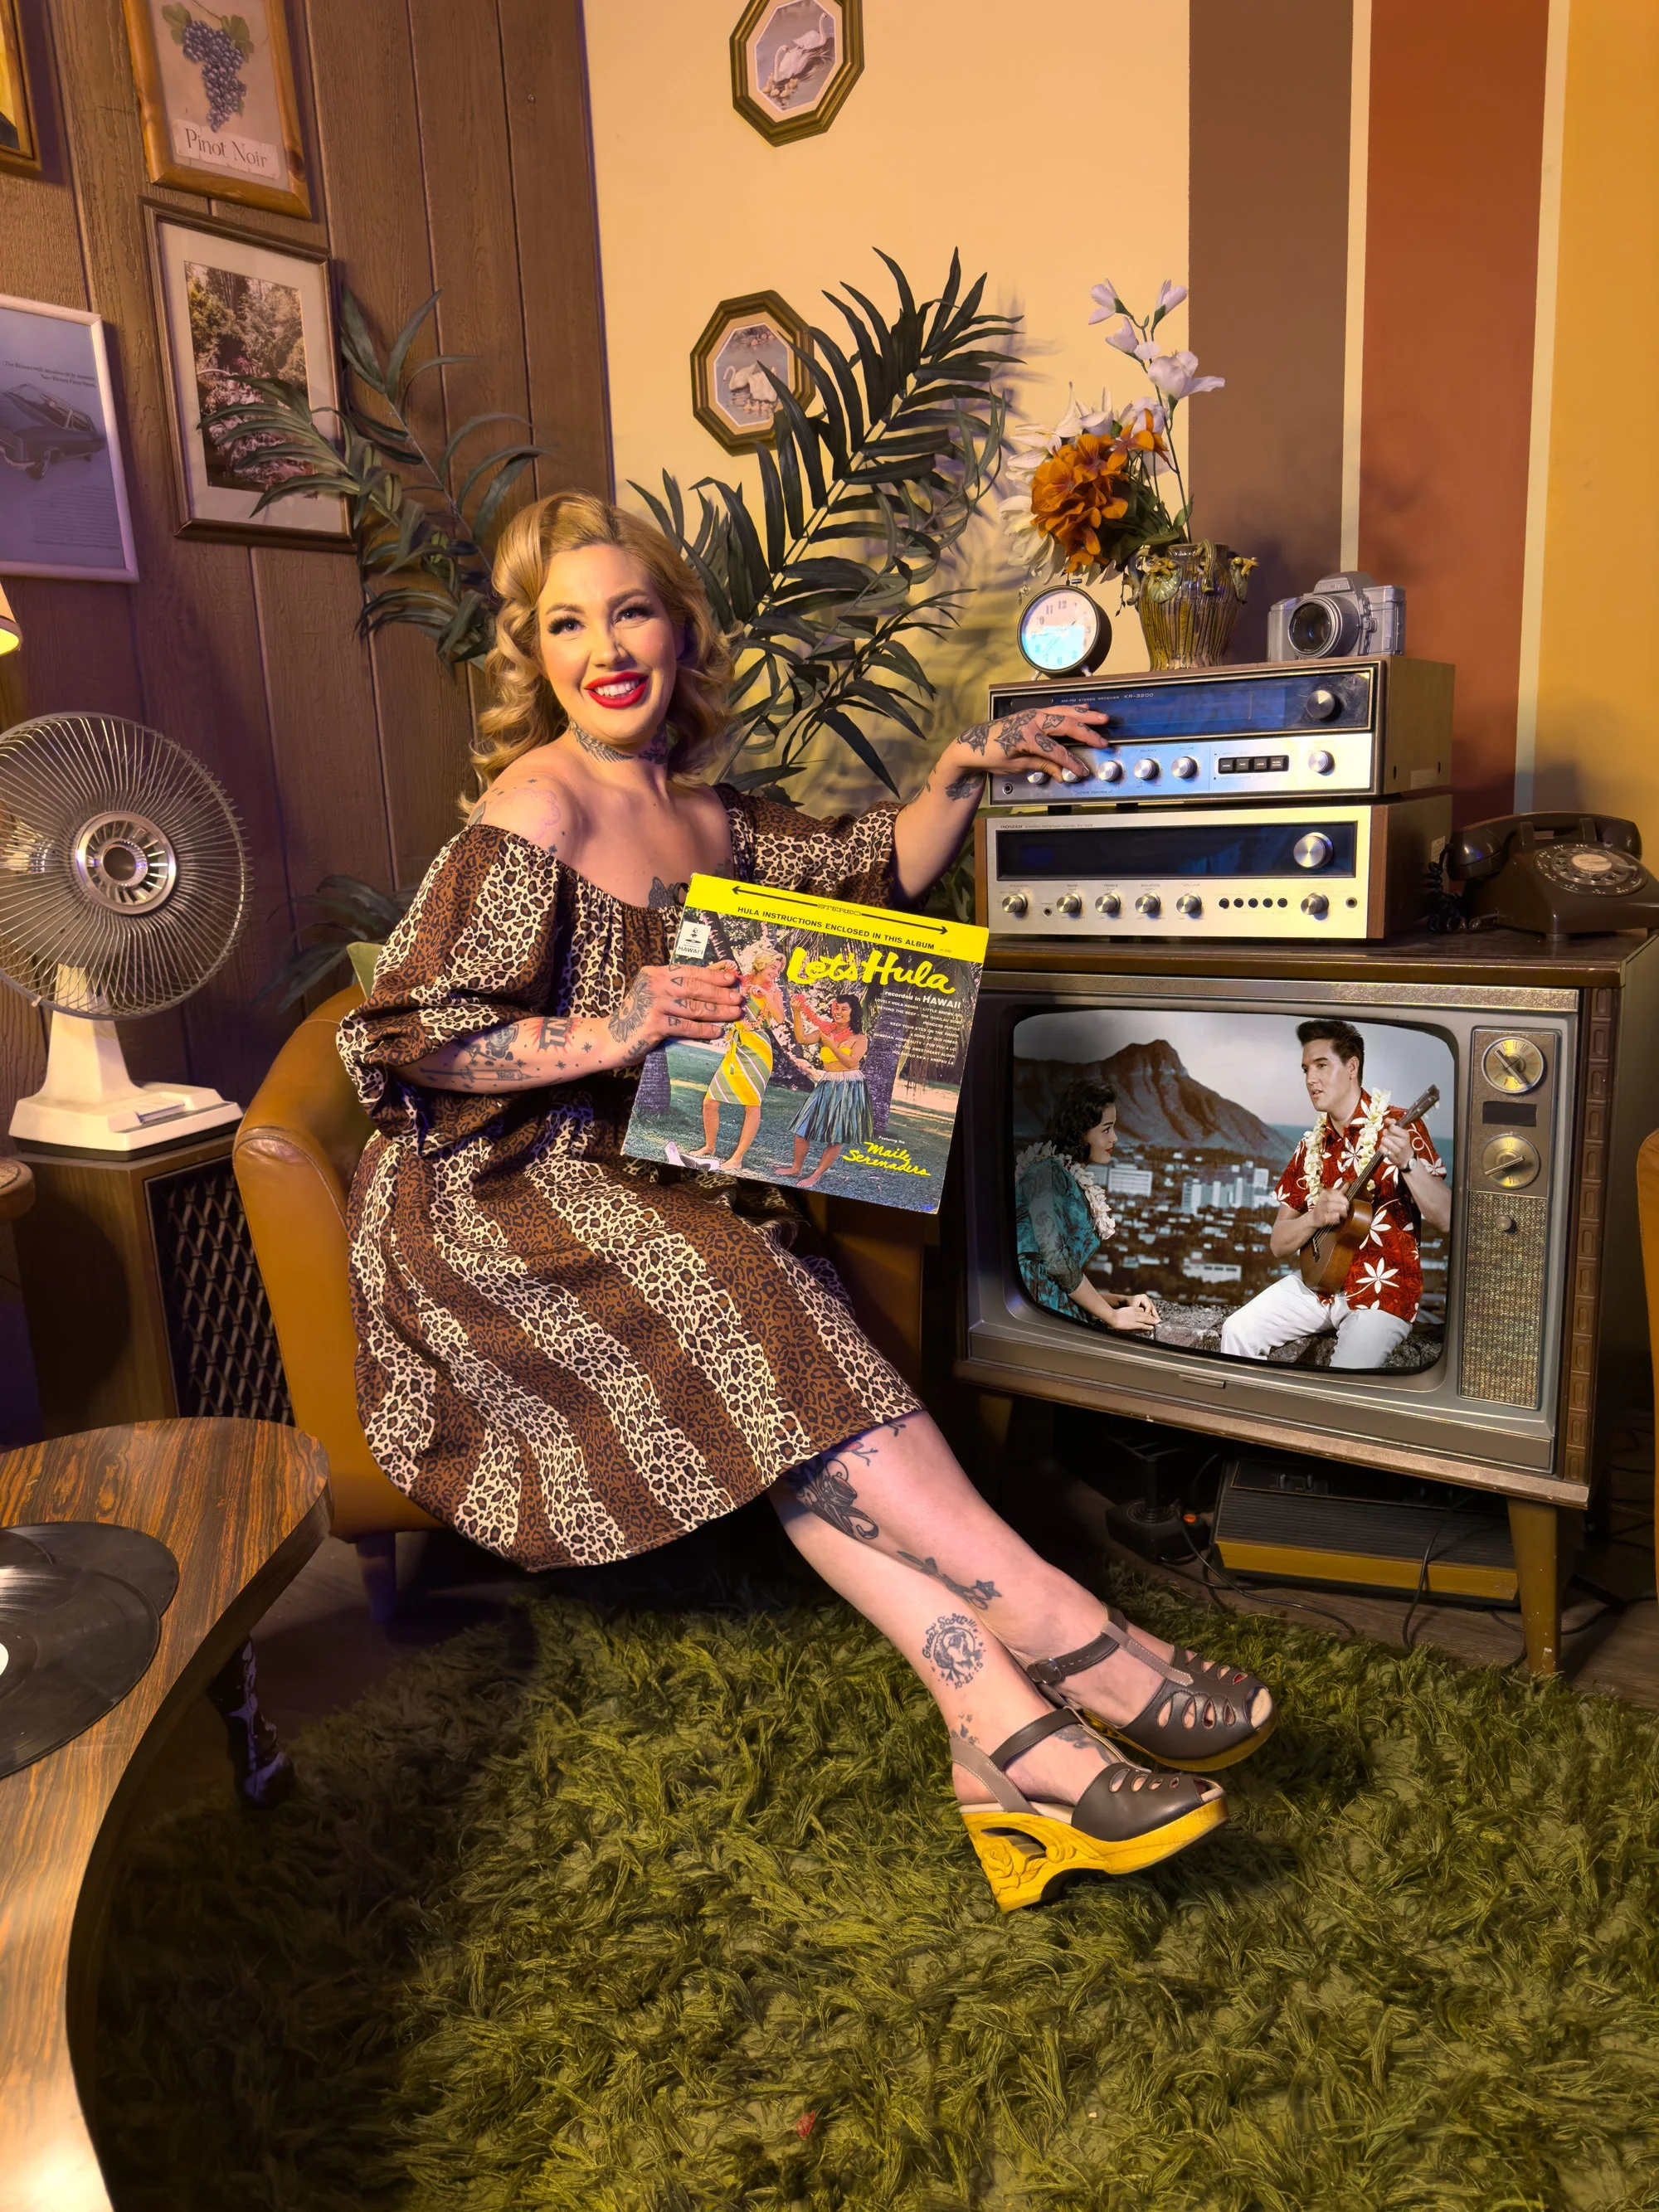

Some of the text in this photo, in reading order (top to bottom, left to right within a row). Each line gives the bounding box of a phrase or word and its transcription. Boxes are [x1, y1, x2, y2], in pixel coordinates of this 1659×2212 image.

[184, 127, 268, 168] Pinot Noir
[1046, 605, 1053, 615] 11
[1058, 600, 1067, 610] 12
[817, 902, 863, 916] STEREO
[737, 907, 760, 916] HULA
[762, 911, 823, 928] INSTRUCTIONS
[825, 922, 870, 938] ENCLOSED
[884, 934, 903, 944] THIS
[905, 938, 935, 950] ALBUM
[786, 946, 956, 994] Let's Hula
[884, 991, 913, 1000] recorded
[922, 994, 961, 1009] HAWAII
[912, 1047, 941, 1056] SWEETHEART
[1501, 1042, 1509, 1052] 12
[1512, 1040, 1518, 1049] 11
[878, 1135, 898, 1144] Featuring
[864, 1141, 912, 1163] Maile
[842, 1150, 932, 1177] Serenaders
